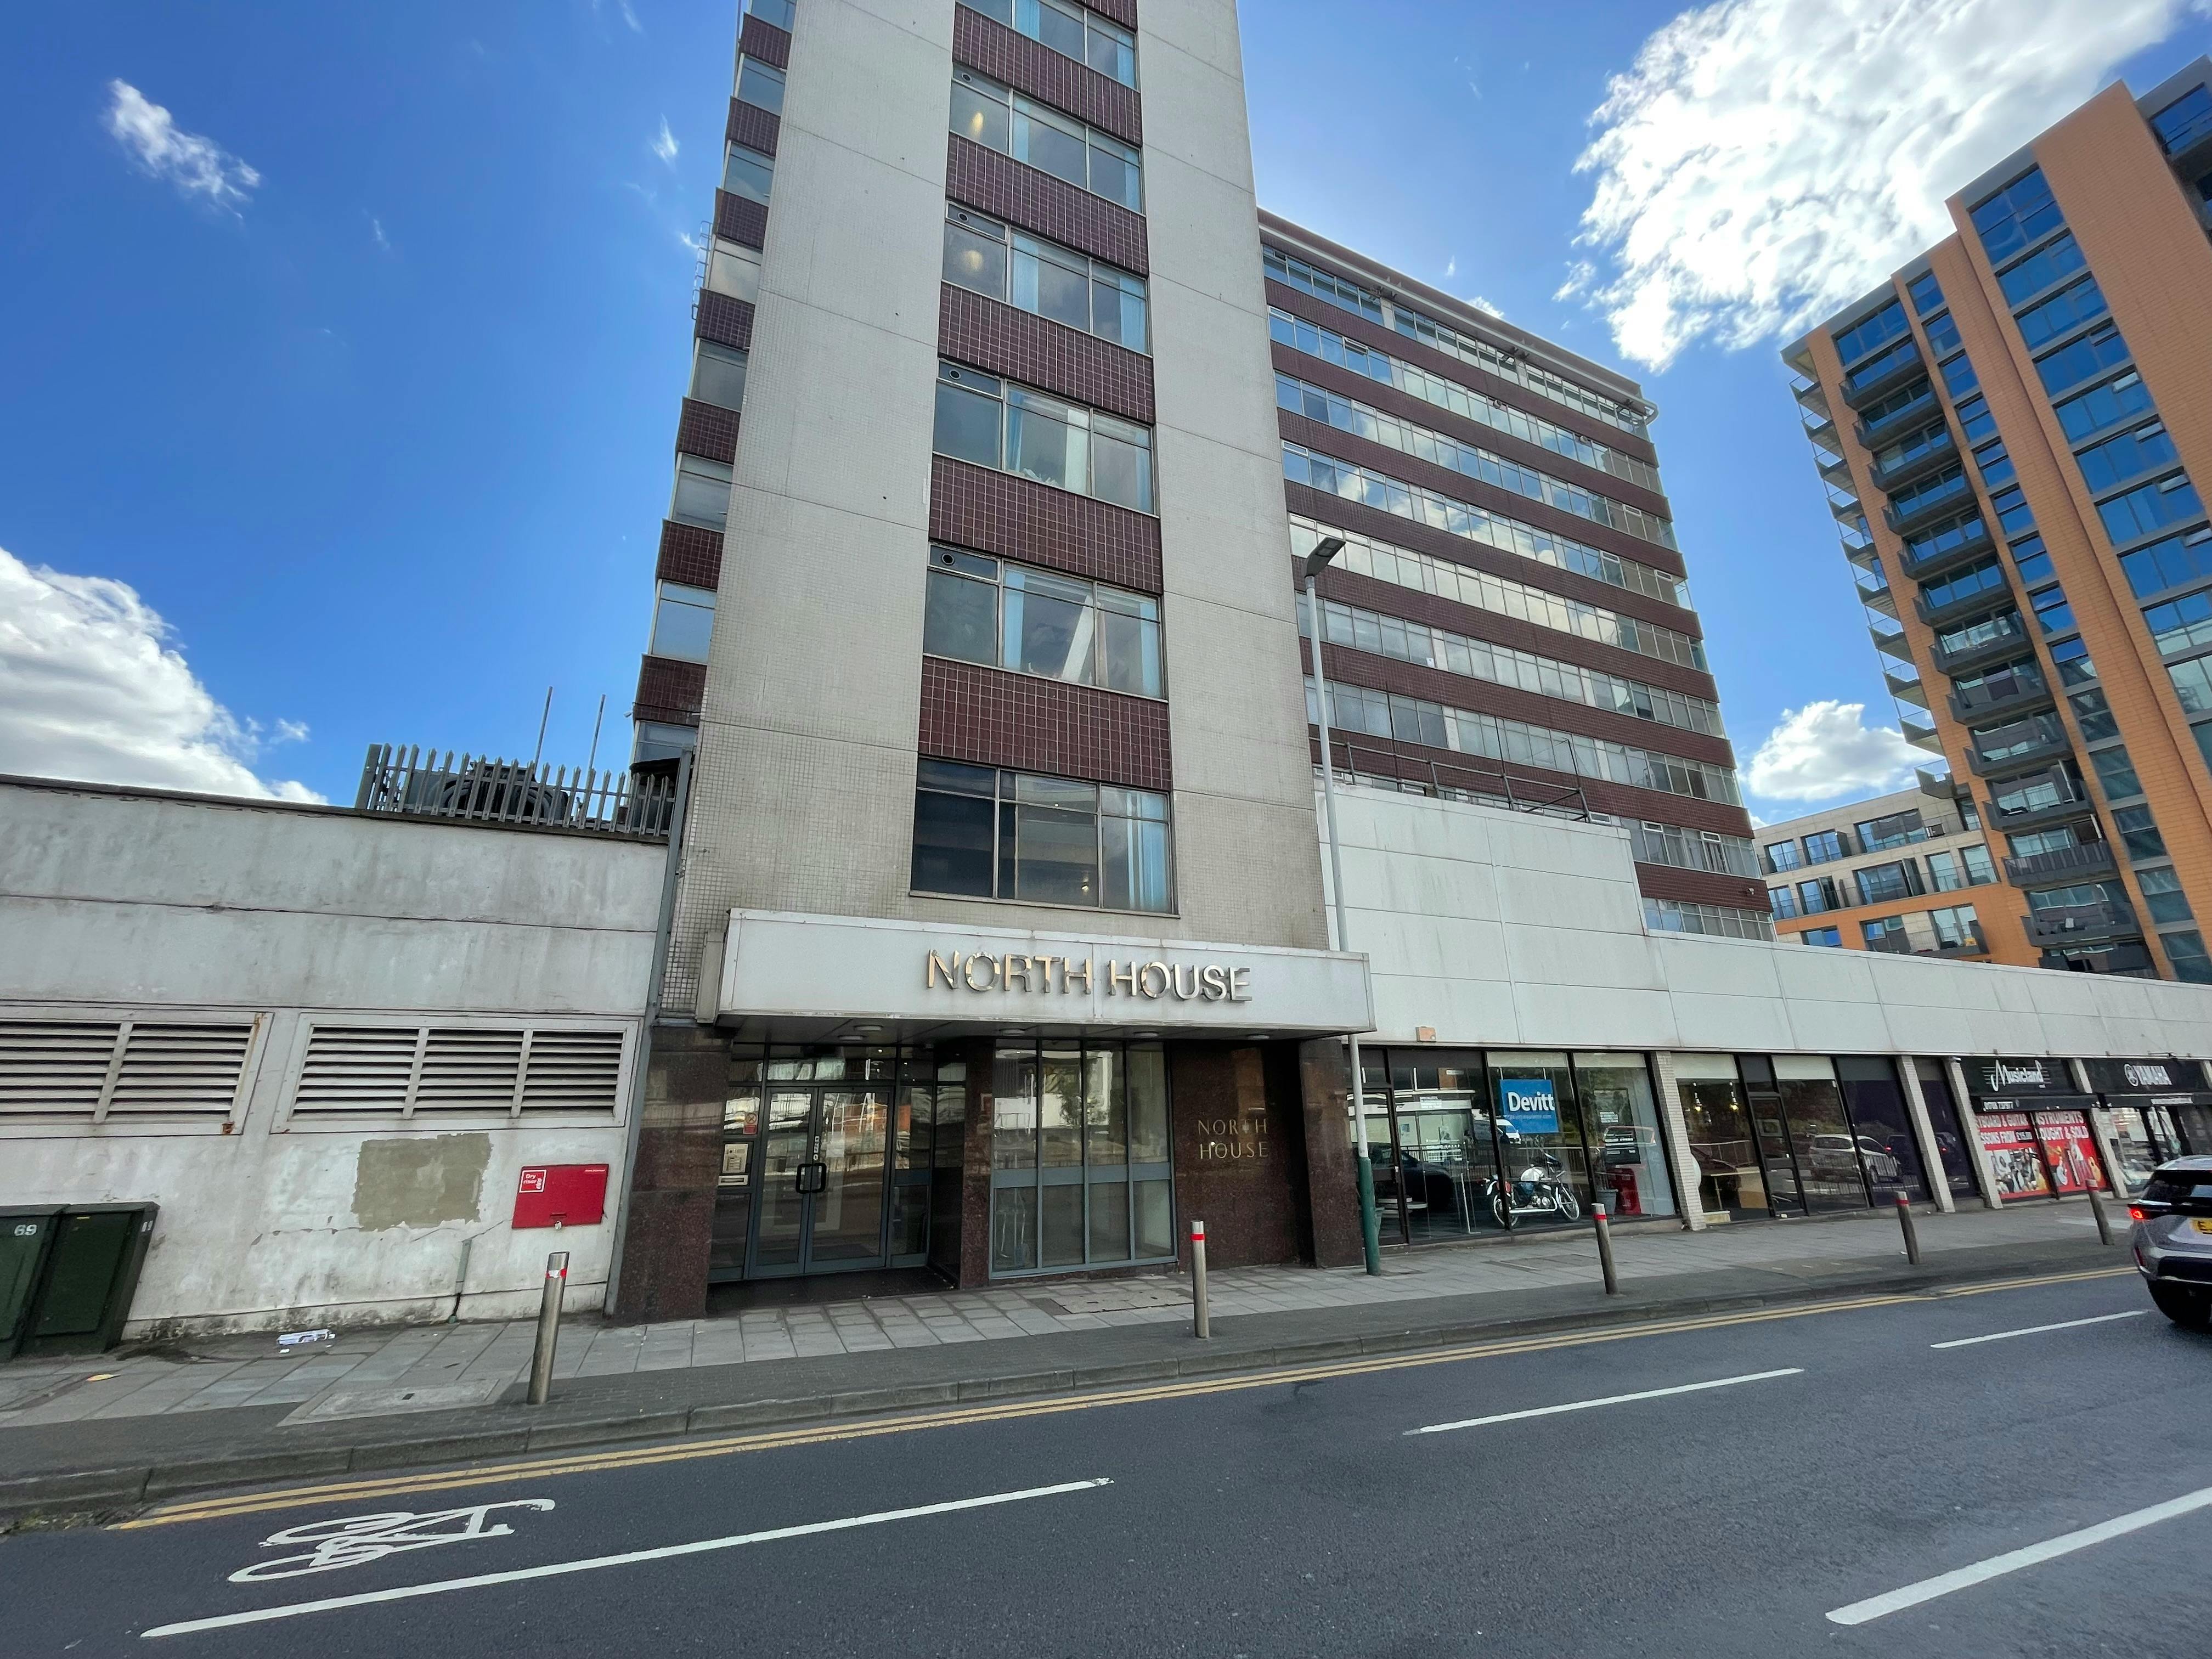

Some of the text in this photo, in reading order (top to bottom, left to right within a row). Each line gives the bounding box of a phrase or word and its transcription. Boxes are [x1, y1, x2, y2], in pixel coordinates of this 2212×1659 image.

[928, 949, 1252, 1002] NORTH HOUSE
[1990, 1059, 2044, 1091] Musicland
[2132, 1065, 2172, 1085] YAMAHA
[1508, 1091, 1555, 1111] Devitt
[1198, 1119, 1267, 1135] NORTH
[2039, 1126, 2064, 1141] OUGHT
[2064, 1126, 2072, 1139] &
[2070, 1126, 2089, 1138] SOLD
[1200, 1141, 1268, 1159] HOUSE
[14, 1224, 37, 1236] 69
